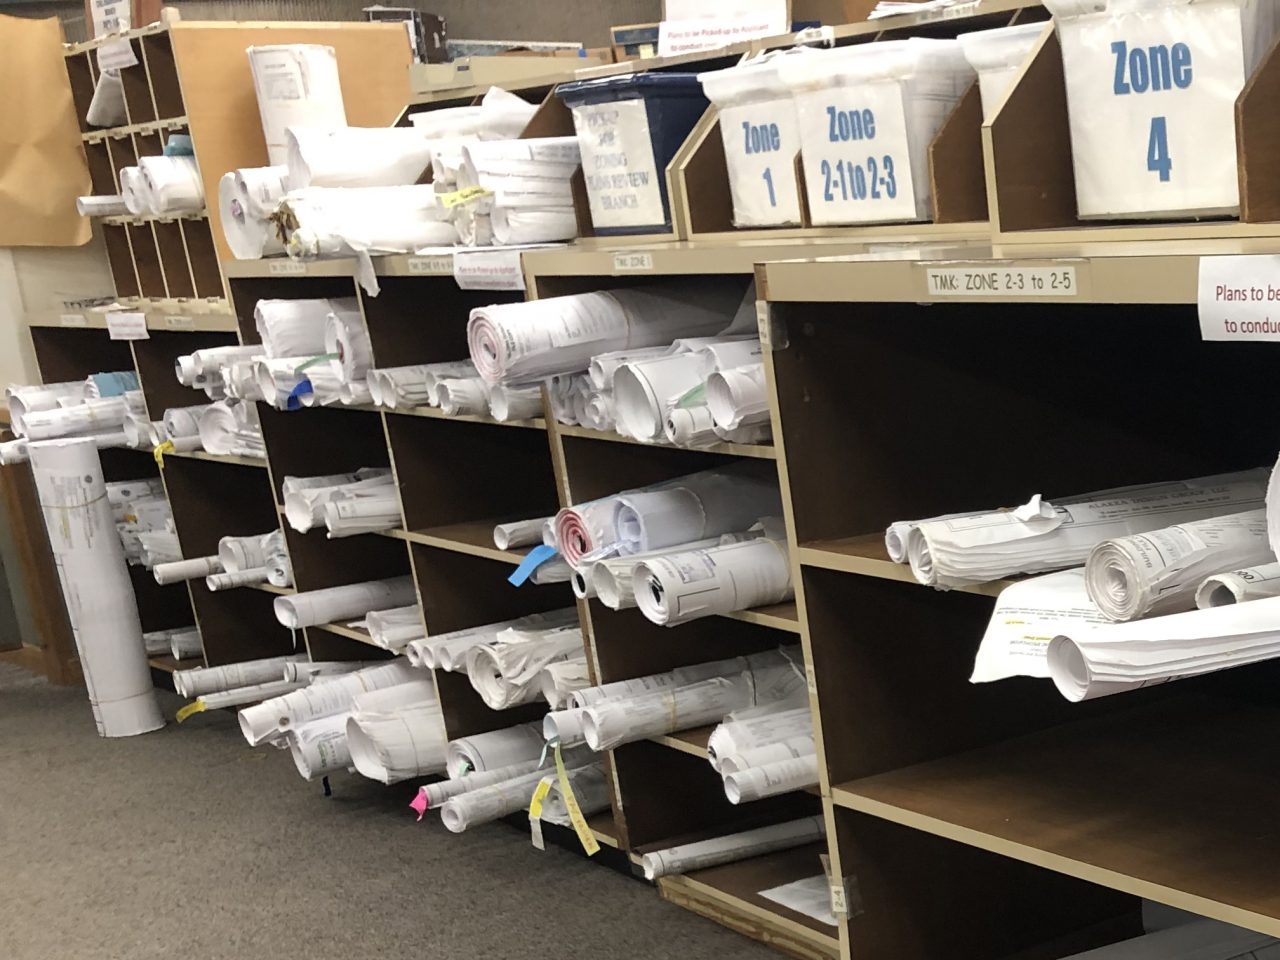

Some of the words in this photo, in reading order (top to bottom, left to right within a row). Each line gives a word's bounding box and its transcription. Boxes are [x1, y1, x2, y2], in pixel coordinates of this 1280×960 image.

[1111, 41, 1193, 95] Zone
[742, 122, 780, 154] Zone
[827, 106, 876, 142] Zone
[1147, 116, 1172, 182] 4
[763, 168, 776, 207] 1
[821, 160, 847, 202] 2-1
[848, 161, 867, 200] to
[867, 155, 897, 200] 2-3
[932, 274, 959, 290] TMK:
[965, 273, 998, 290] ZONE
[1005, 273, 1024, 289] 2-3
[1031, 274, 1043, 289] to
[1051, 272, 1071, 289] 2-5
[1216, 285, 1248, 302] Plans
[1250, 286, 1264, 301] to
[1224, 318, 1238, 333] to
